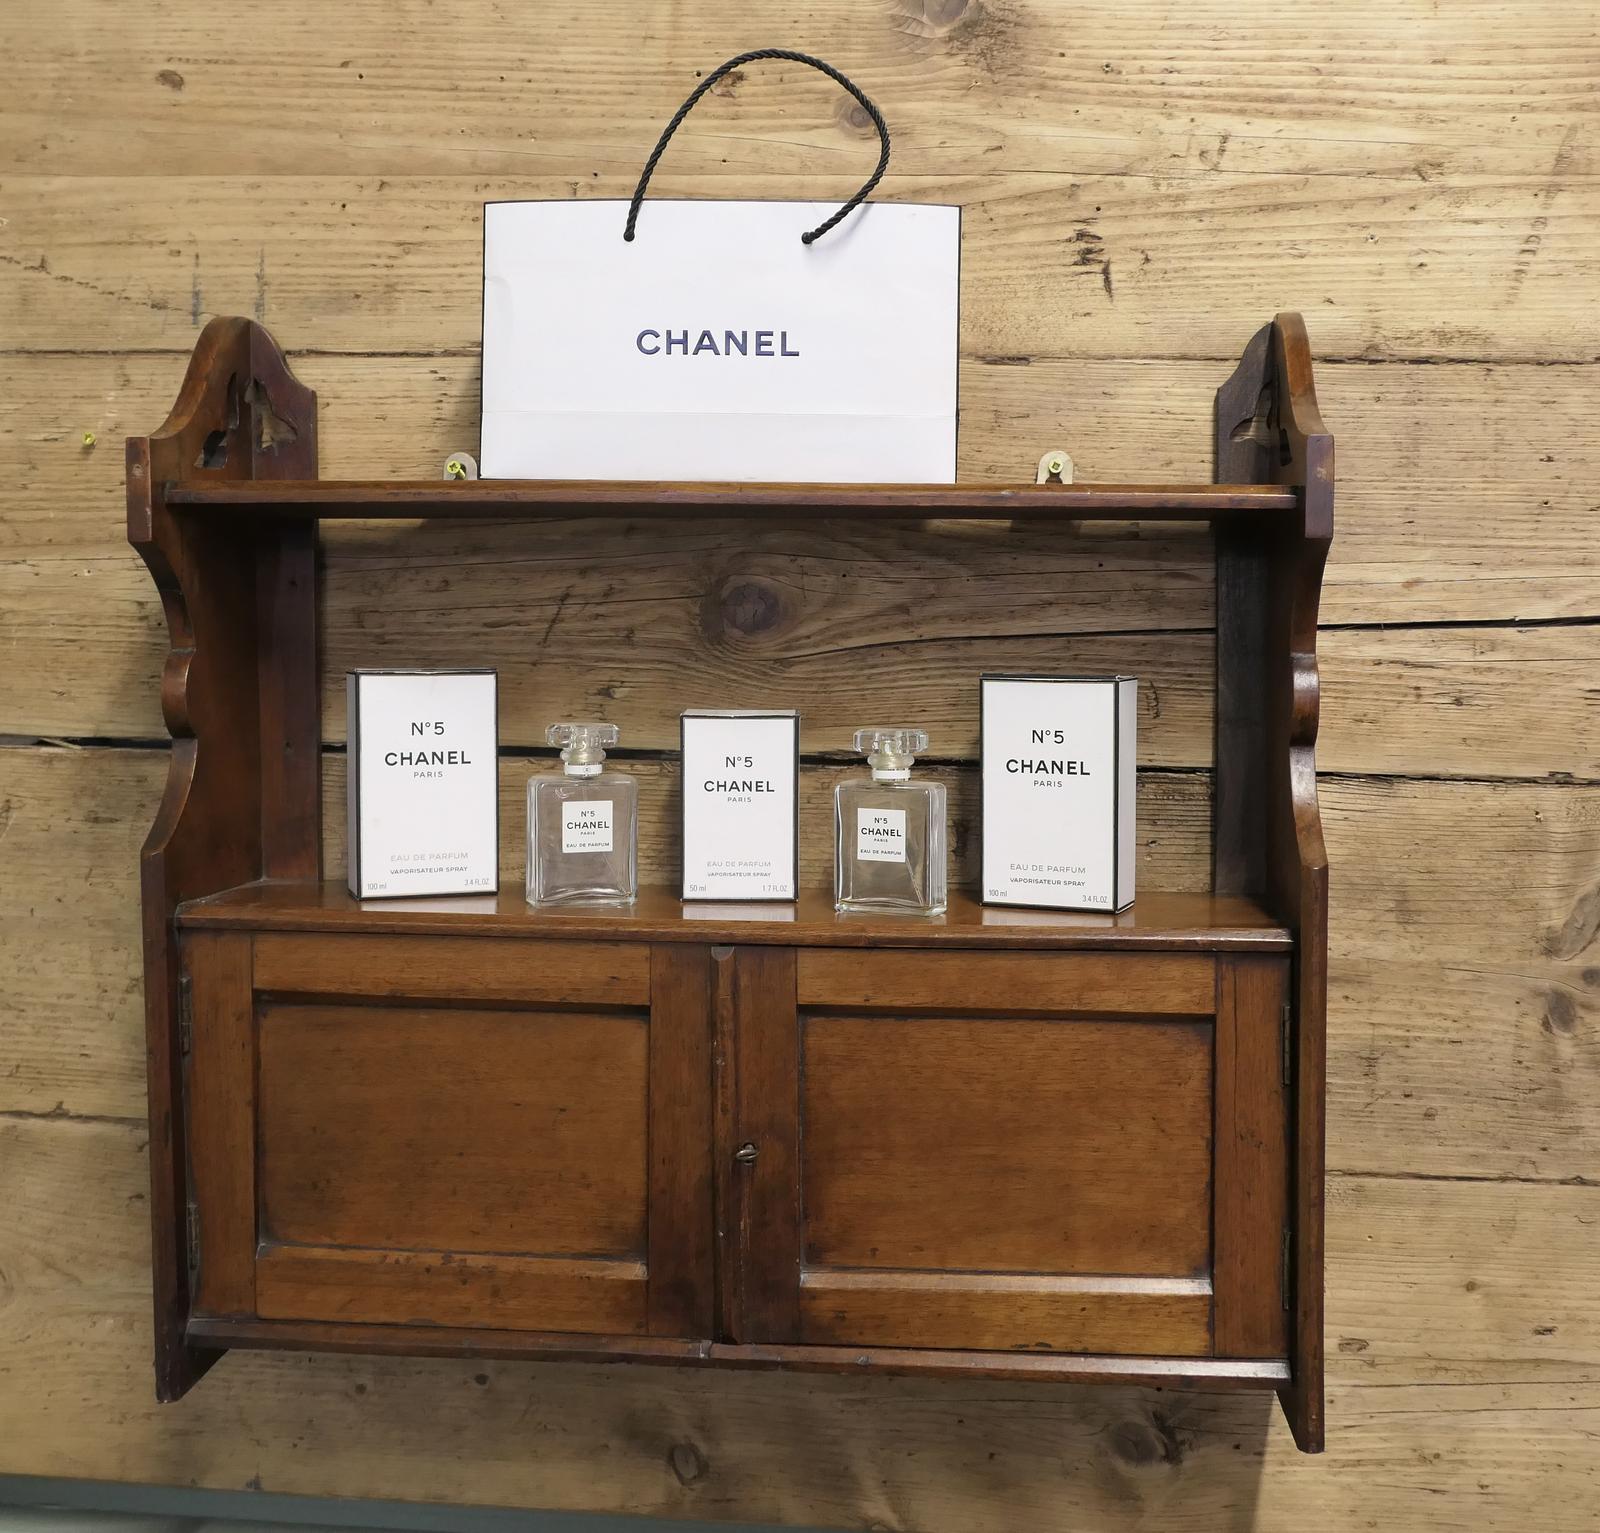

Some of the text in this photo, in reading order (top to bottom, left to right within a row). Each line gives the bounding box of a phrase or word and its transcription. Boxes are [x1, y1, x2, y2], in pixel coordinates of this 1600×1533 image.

[636, 329, 800, 357] CHANEL
[384, 750, 472, 766] CHANEL
[1006, 758, 1091, 776] CHANEL
[703, 780, 775, 792] CHANEL
[566, 821, 610, 829] CHANEL
[860, 827, 902, 837] CHANEL
[390, 854, 410, 862] EAU
[429, 852, 469, 860] PARFUM
[390, 867, 444, 875] VAPORISATEUR
[1010, 863, 1086, 874] EAU DE PARFUM
[1010, 877, 1062, 885] VAPORISATEUR
[689, 884, 707, 892] 50 ml
[988, 889, 999, 897] 100
